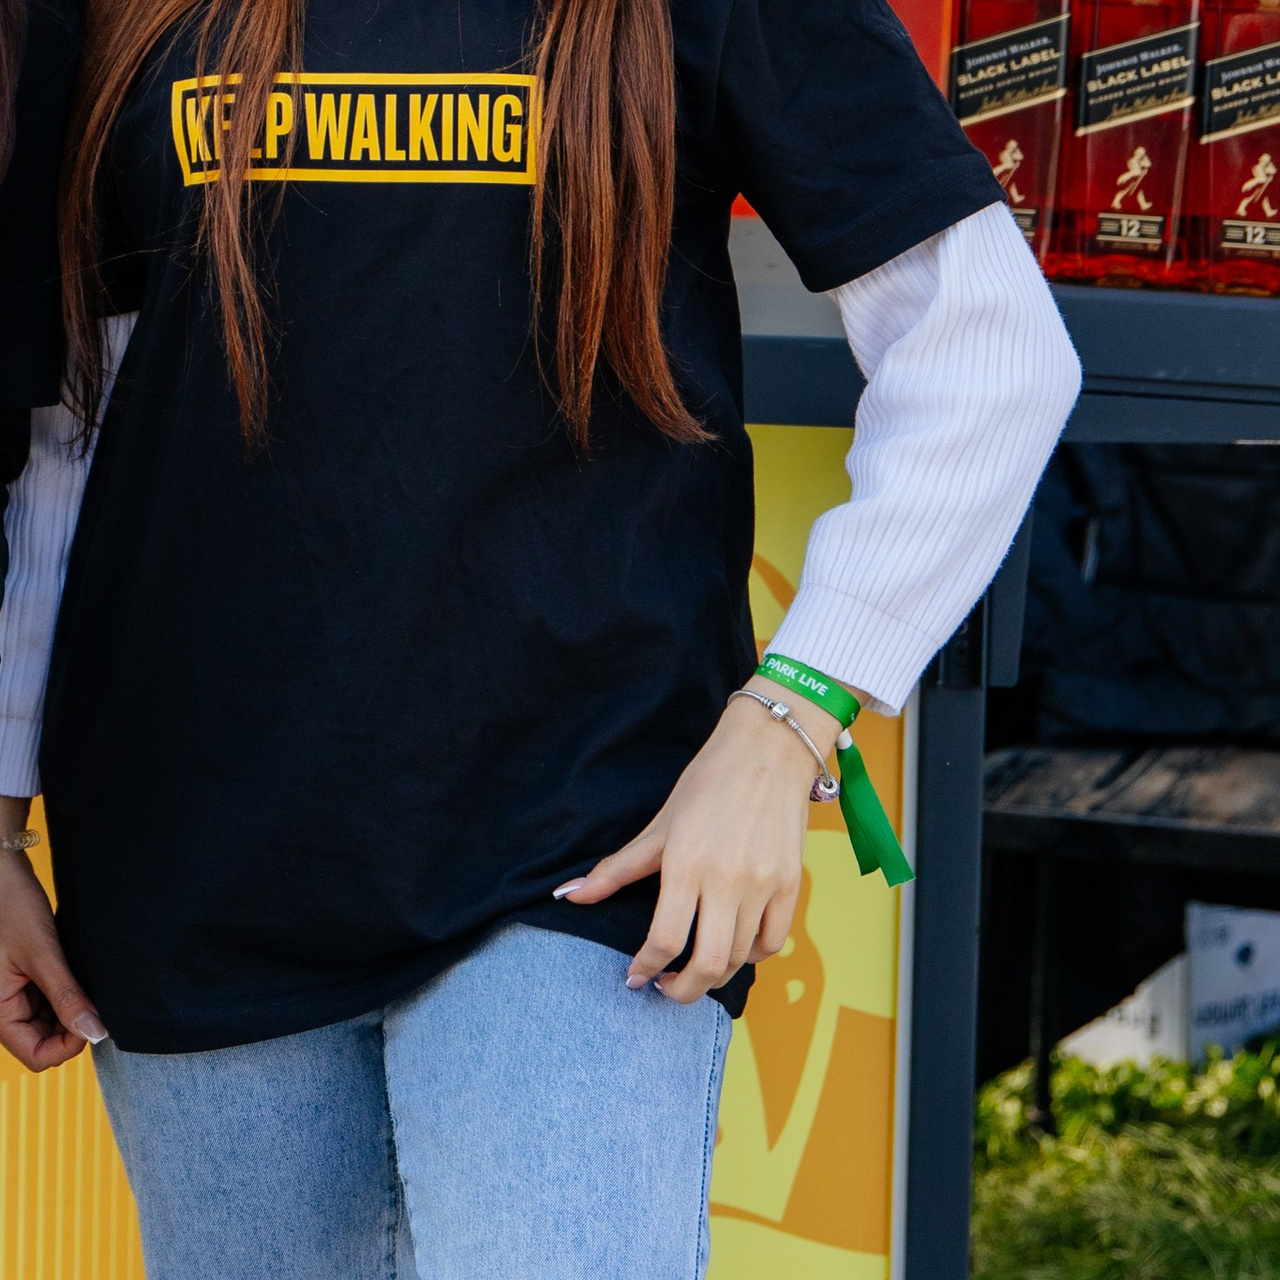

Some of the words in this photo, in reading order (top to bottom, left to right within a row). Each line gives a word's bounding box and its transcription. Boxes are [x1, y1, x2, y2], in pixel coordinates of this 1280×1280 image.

[965, 48, 1007, 70] JOHNNIE
[1095, 54, 1138, 76] JOHNNIE
[957, 63, 1008, 87] BLACK
[1086, 69, 1139, 93] BLACK
[1220, 62, 1263, 84] JOHNNIE
[1211, 76, 1264, 100] BLACK
[186, 92, 293, 163] KEP
[304, 93, 523, 163] WALKING
[1120, 219, 1141, 237] 12
[1245, 226, 1266, 244] 12
[766, 657, 800, 680] PARK
[798, 673, 828, 696] LIVE
